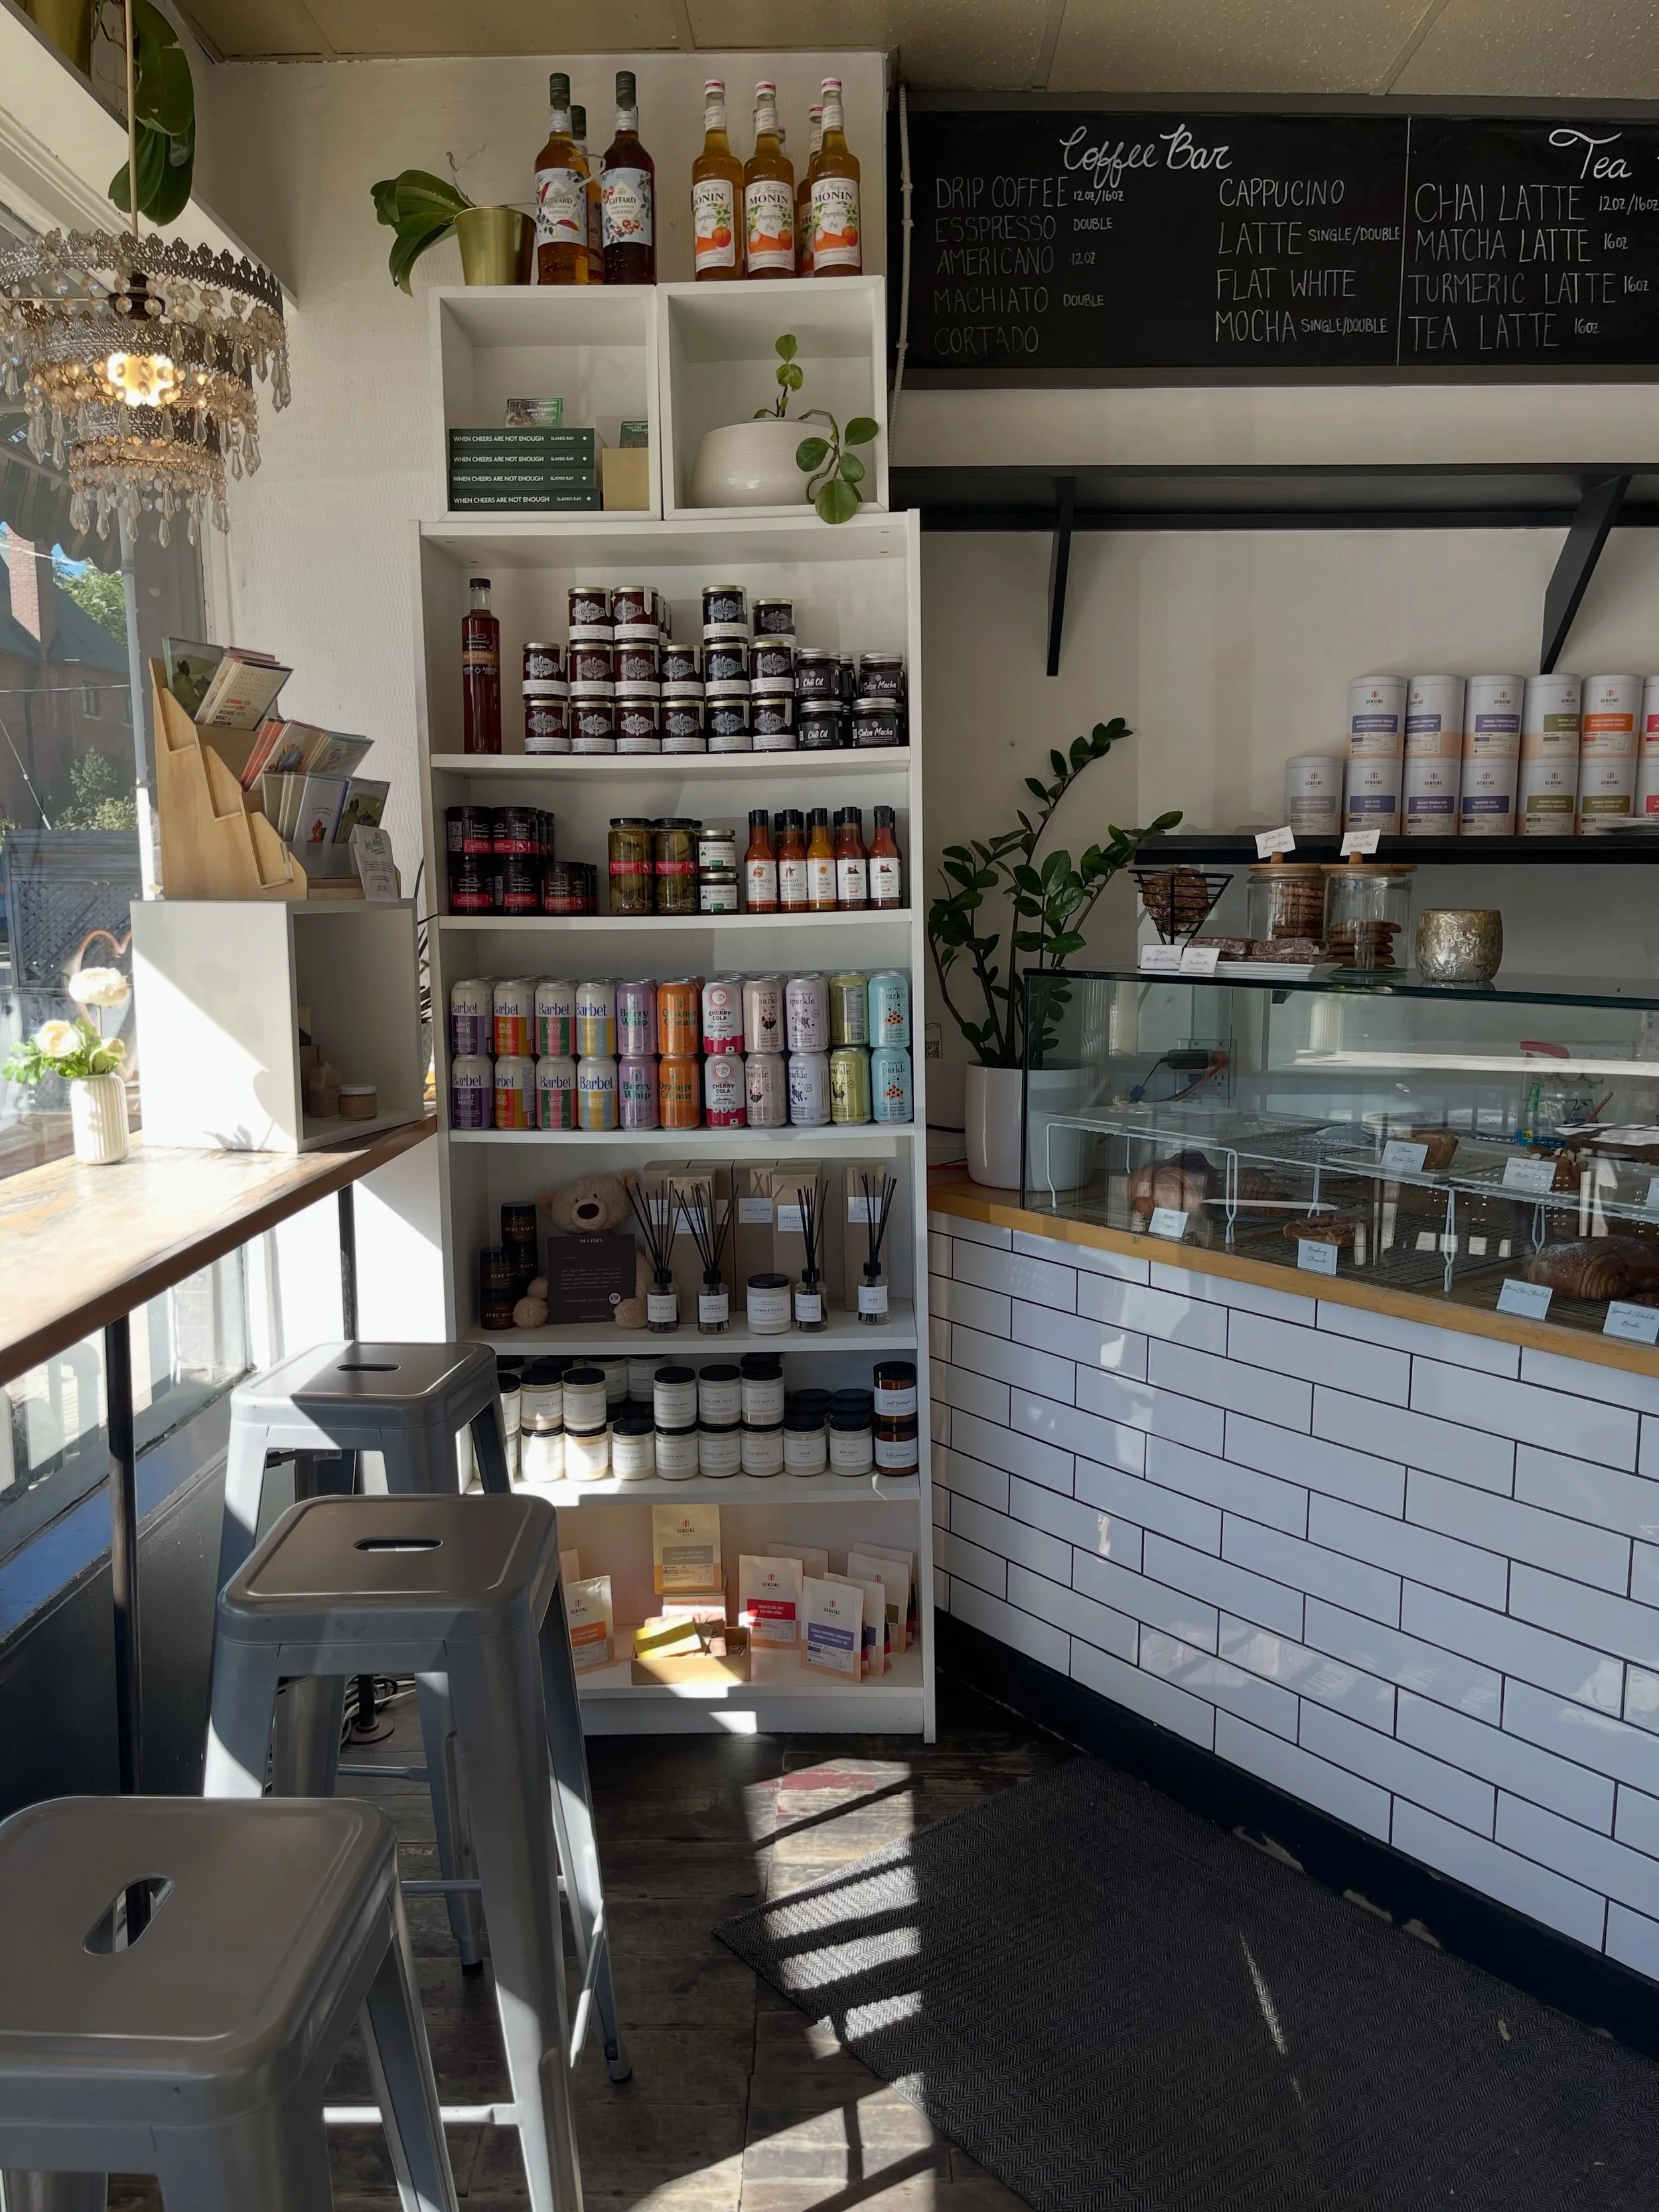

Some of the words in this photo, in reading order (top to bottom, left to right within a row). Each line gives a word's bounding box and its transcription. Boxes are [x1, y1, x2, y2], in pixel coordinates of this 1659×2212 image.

[1060, 126, 1157, 188] Coffee
[1161, 123, 1232, 170] Bar
[1549, 129, 1632, 179] Tea
[749, 194, 788, 204] MONIN
[815, 192, 853, 202] MONIN
[936, 177, 983, 208] DRIP
[991, 176, 1068, 207] COFFEE
[1220, 179, 1344, 207] CAPPUCINO
[1415, 183, 1484, 222] CHAI
[1499, 184, 1585, 221] LATTE
[936, 215, 1056, 242] ESSPRESSO
[1073, 217, 1113, 231] DOUBLE
[1218, 221, 1303, 256] LATTE
[1308, 226, 1401, 245] SINGLE/DOUBLE
[1415, 229, 1506, 262] MATCHA
[1519, 229, 1592, 262] LATTE
[937, 247, 1054, 276] AMERICANO
[1216, 268, 1277, 301] FLAT
[1291, 269, 1356, 297] WHITE
[1407, 273, 1525, 304] TURMERIC
[1545, 273, 1616, 304] LATTE
[934, 287, 1048, 315] MACHIATO
[1063, 293, 1104, 307] DOUBLE
[1216, 310, 1297, 342] MOCHA
[1301, 316, 1388, 334] SINGLE/DOUBLE
[1408, 316, 1457, 351] TEA
[1480, 313, 1559, 349] LATTE
[935, 326, 1039, 355] CORTADO
[803, 678, 814, 687] Chili
[863, 682, 876, 691] Salsa
[878, 680, 897, 689] Macha
[808, 731, 819, 739] Chili
[858, 728, 873, 738] Salsa
[875, 727, 893, 736] Macha
[452, 1001, 478, 1014] Barbet
[790, 995, 815, 1006] sparkle
[539, 1003, 570, 1015] Barbet
[576, 1002, 608, 1016] Barbet
[620, 1008, 648, 1019] Berry
[621, 1017, 648, 1027] Whip
[453, 1074, 481, 1086] Barbet
[540, 1075, 571, 1088] Barbet
[580, 1076, 613, 1090] Barbet
[623, 1081, 651, 1091] Berry
[659, 1080, 691, 1092] Orange
[624, 1089, 650, 1100] Whip
